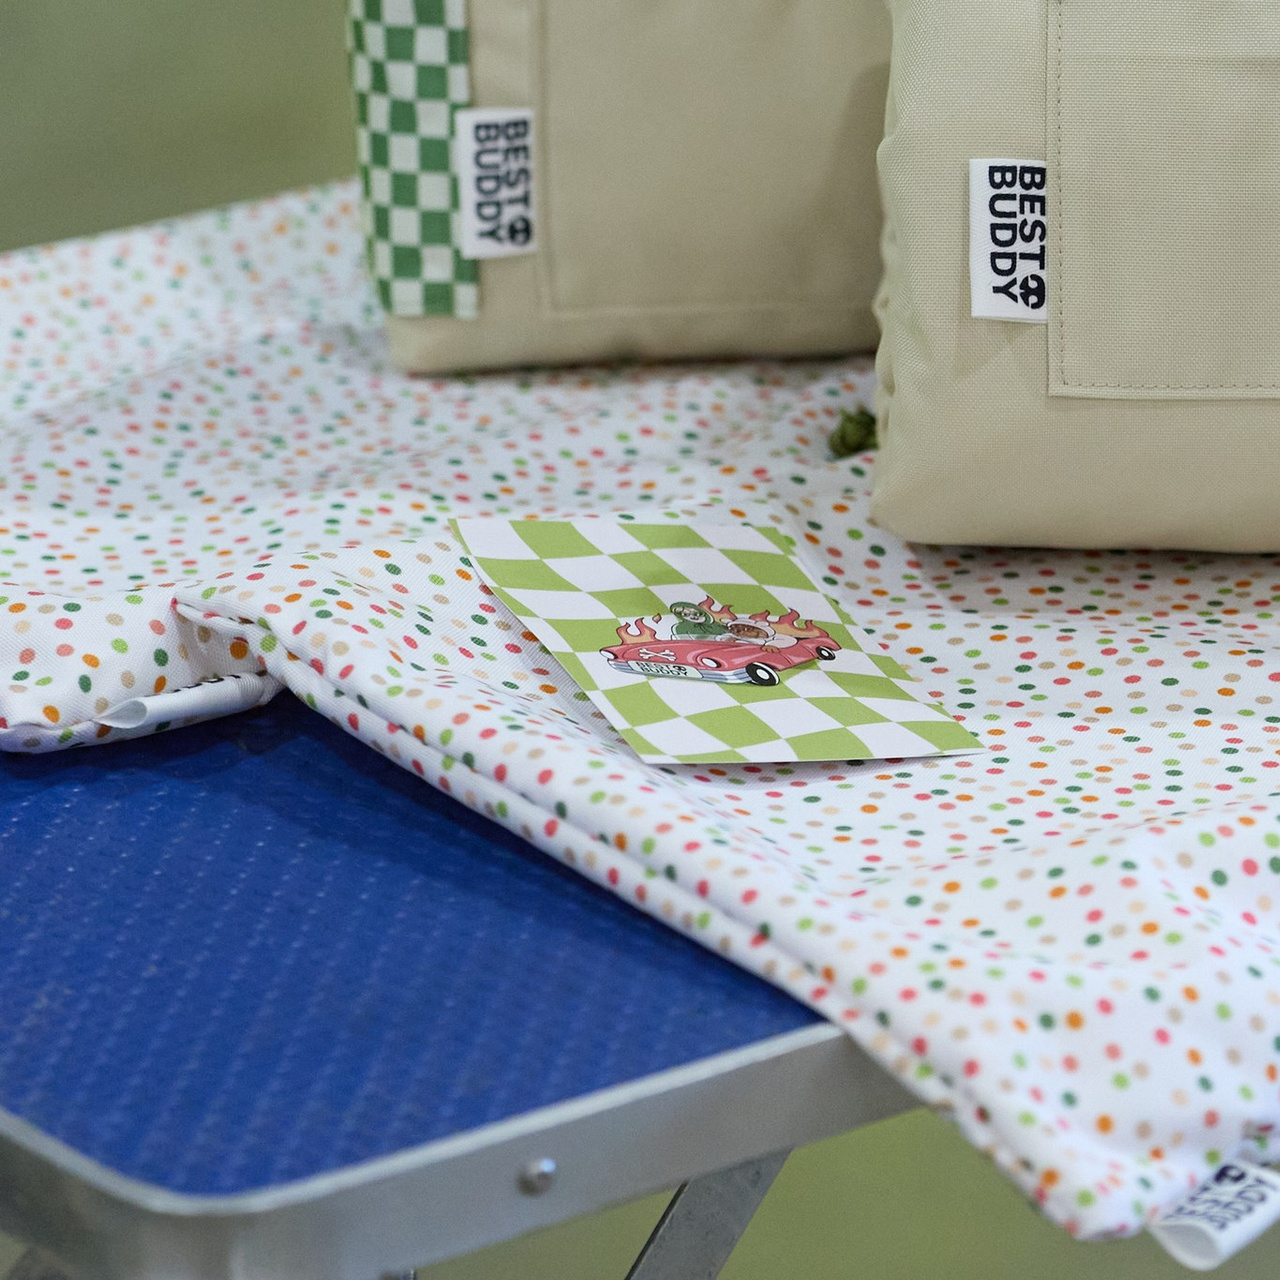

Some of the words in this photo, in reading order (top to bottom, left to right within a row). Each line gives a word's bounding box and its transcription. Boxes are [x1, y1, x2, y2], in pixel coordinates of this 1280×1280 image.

[474, 122, 503, 243] BUDDY
[503, 119, 530, 208] BEST
[988, 165, 1019, 304] BUDDY
[1018, 165, 1047, 271] BEST
[640, 666, 688, 677] BUDDY
